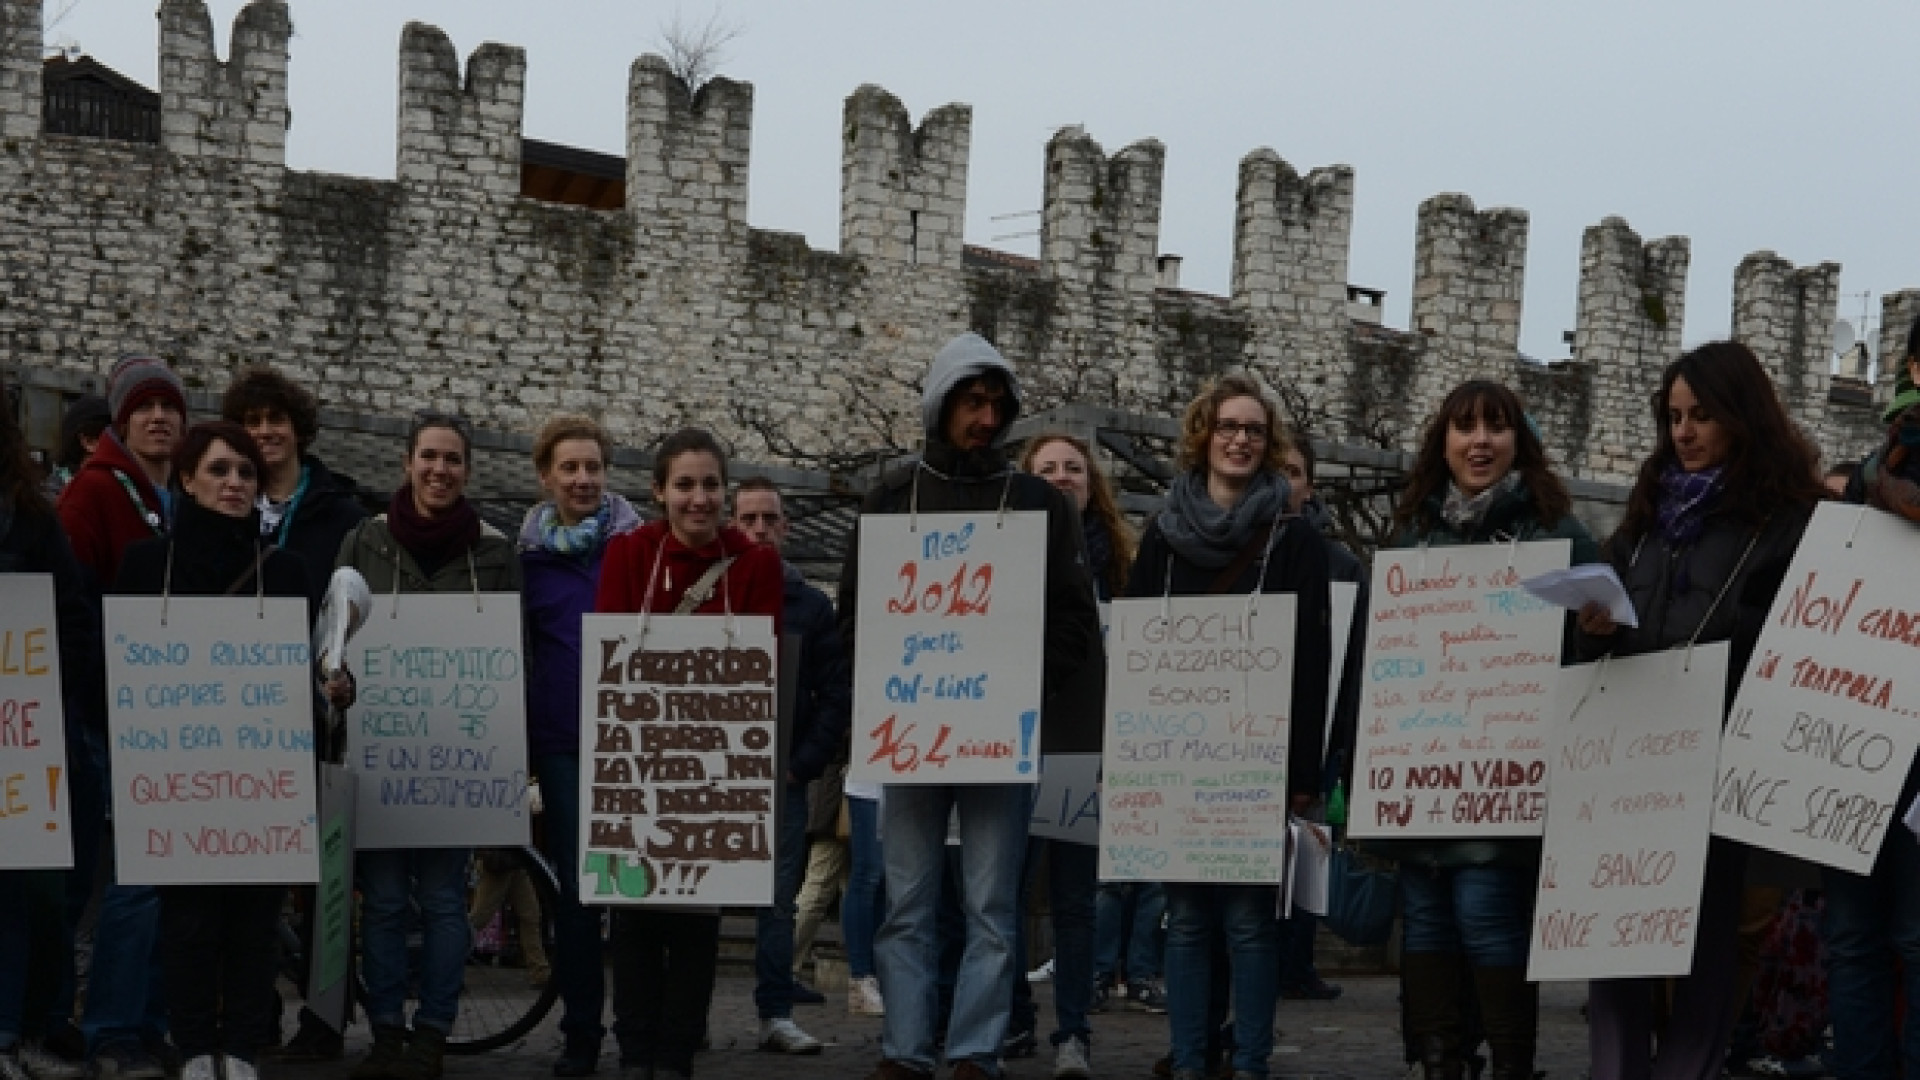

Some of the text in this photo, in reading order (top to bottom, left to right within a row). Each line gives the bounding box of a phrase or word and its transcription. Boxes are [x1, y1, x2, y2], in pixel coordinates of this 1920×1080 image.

[922, 522, 976, 560] nel
[886, 560, 993, 617] 2012
[1780, 571, 1863, 634] NON
[1142, 612, 1258, 644] GIOCHI
[2, 628, 49, 676] LE
[1126, 646, 1282, 675] D'AZZARDO
[117, 680, 288, 709] A CAPIRE CHE
[441, 683, 499, 713] 100
[1149, 684, 1231, 706] SONO:
[0, 699, 41, 749] RE
[119, 727, 169, 751] NON
[179, 724, 223, 749] ERA
[458, 715, 488, 739] 75
[594, 723, 770, 752] LA BORSA O
[1114, 711, 1206, 737] BINGO
[1118, 739, 1287, 764] SLOT MACHINE
[1561, 727, 1617, 770] NON
[1781, 711, 1894, 773] BANCO
[594, 757, 633, 783] LA
[1368, 758, 1546, 791] IO NON VADO
[130, 770, 298, 805] QUESTIONE
[1713, 766, 1894, 855] VINCE SEMPRE
[146, 827, 174, 857] DI
[1590, 849, 1675, 889] BANCO
[1539, 906, 1693, 950] VINCE SEMPRE
